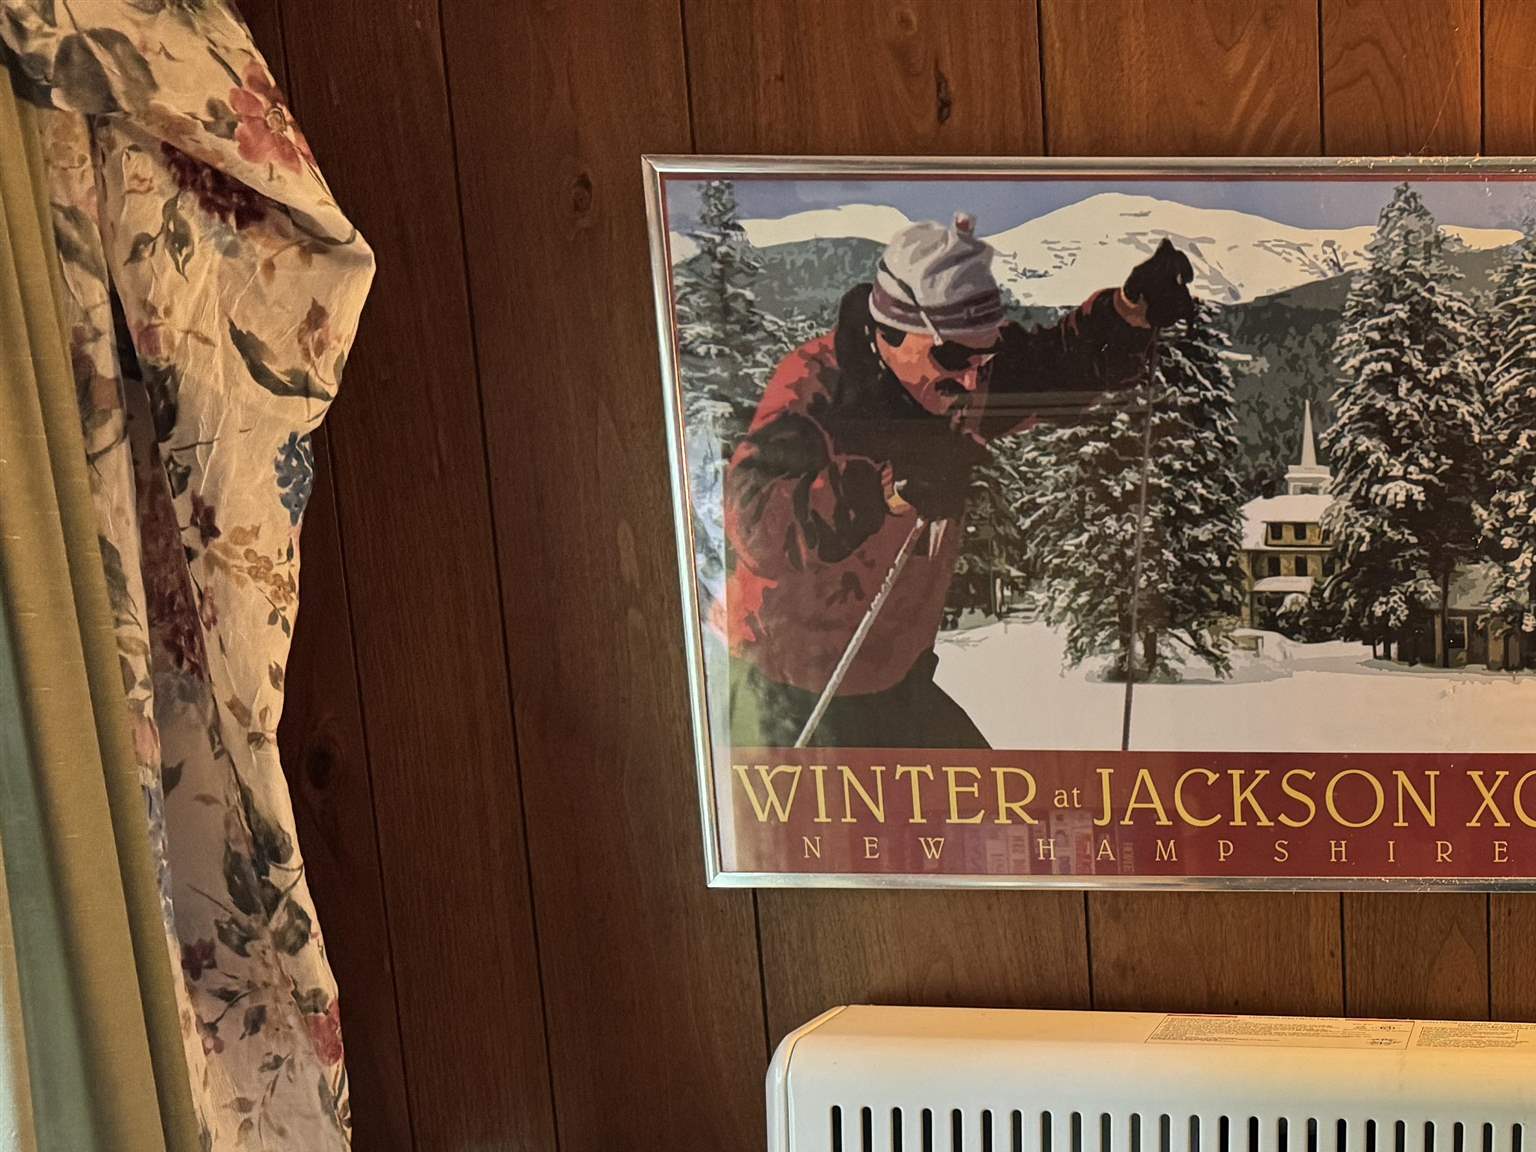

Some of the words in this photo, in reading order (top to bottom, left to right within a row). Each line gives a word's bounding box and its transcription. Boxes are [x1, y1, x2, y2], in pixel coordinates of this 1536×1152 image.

[732, 764, 1038, 825] WINTER
[1054, 785, 1082, 808] at
[1093, 768, 1440, 828] JACKSON
[803, 836, 945, 860] NEW
[1036, 838, 1510, 863] HAMPSHIRE
